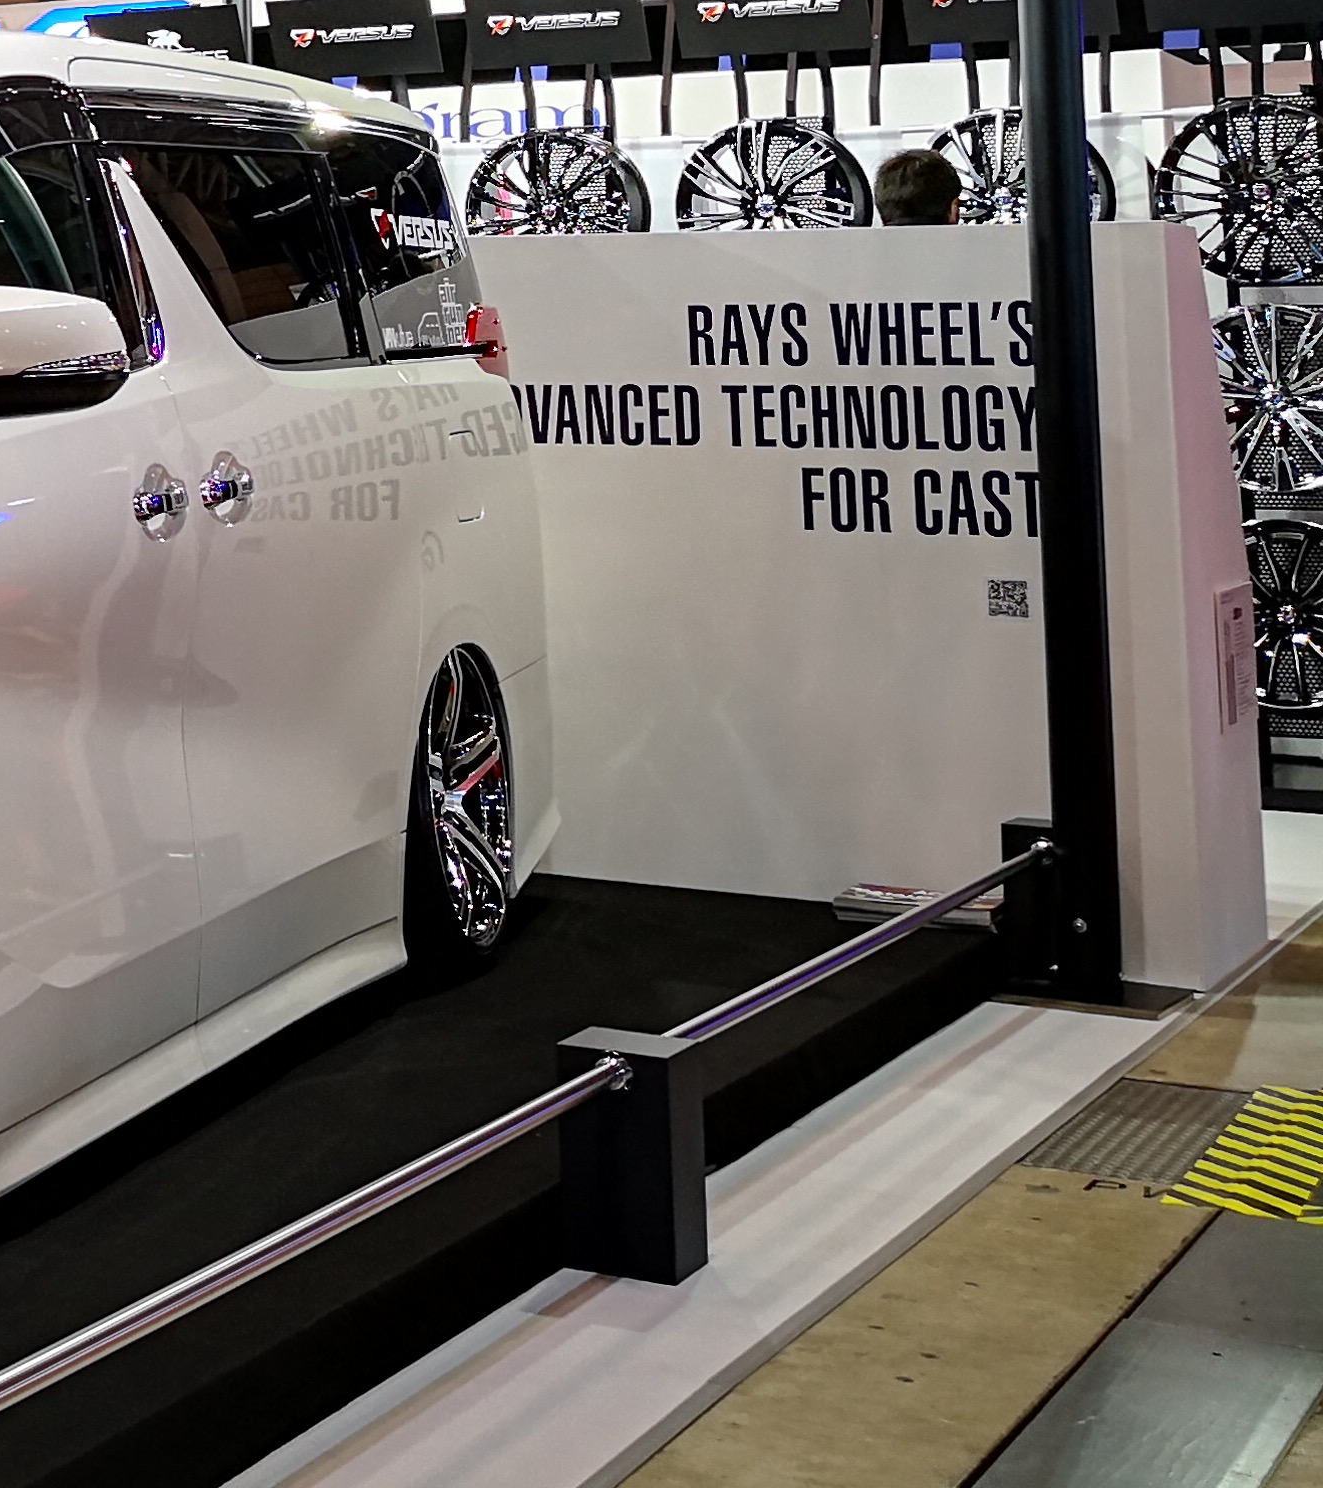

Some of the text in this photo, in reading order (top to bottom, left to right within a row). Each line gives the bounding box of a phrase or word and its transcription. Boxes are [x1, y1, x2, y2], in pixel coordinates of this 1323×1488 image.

[316, 23, 415, 45] VERSUS
[515, 10, 621, 32] VERSUS
[388, 214, 454, 250] VERSUS
[687, 299, 1036, 368] RAYS WHEEL'S
[721, 383, 1038, 453] TECHNOLOGY
[802, 467, 1040, 538] FOR CAST
